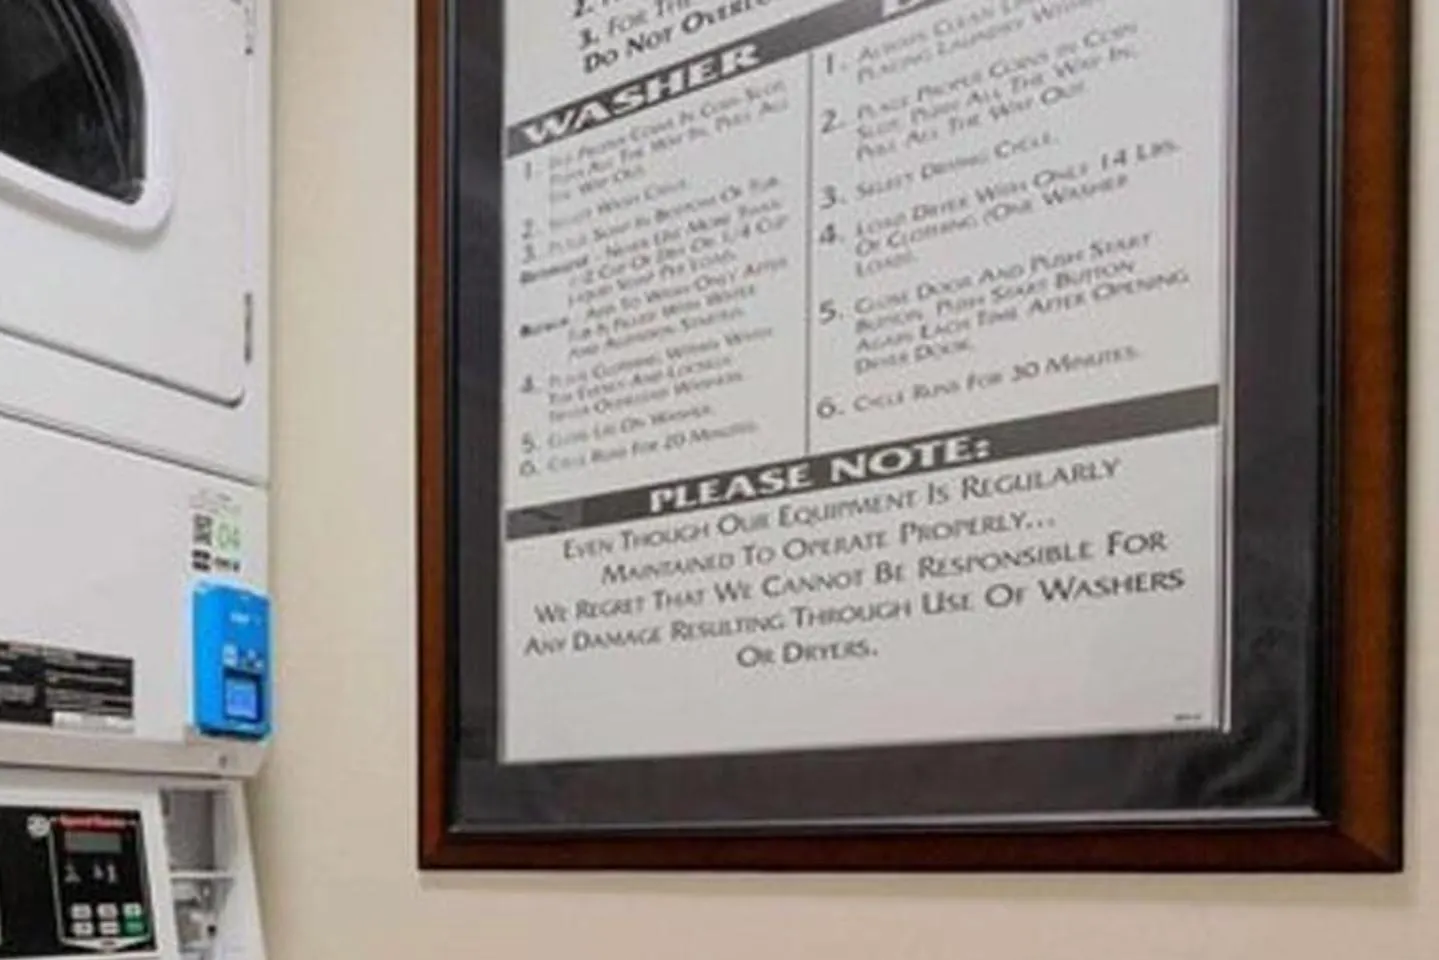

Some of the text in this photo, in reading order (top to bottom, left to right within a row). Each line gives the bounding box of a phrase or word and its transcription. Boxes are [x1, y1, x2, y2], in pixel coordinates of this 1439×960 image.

[582, 48, 618, 76] DO
[625, 26, 673, 59] NOT
[523, 42, 759, 146] WASHER
[1100, 149, 1127, 171] 14
[1091, 269, 1189, 302] OPENING
[1011, 363, 1040, 382] 30
[563, 459, 1120, 559] EVEN THOUGH OUR EQUIPMENT IS REGULARLY
[648, 429, 990, 513] PLEASE NOTE:
[534, 531, 1168, 624] WE REGRET THAT WE CANNOT BE RESPONSIBLE FOR
[601, 508, 1055, 585] MAINTAINED TO OPERATE PROPERLY...
[524, 571, 1184, 656] ANY DAMAGE RESULTING THROUGH USE OF WASHERS
[736, 640, 878, 668] OR DRYERS.
